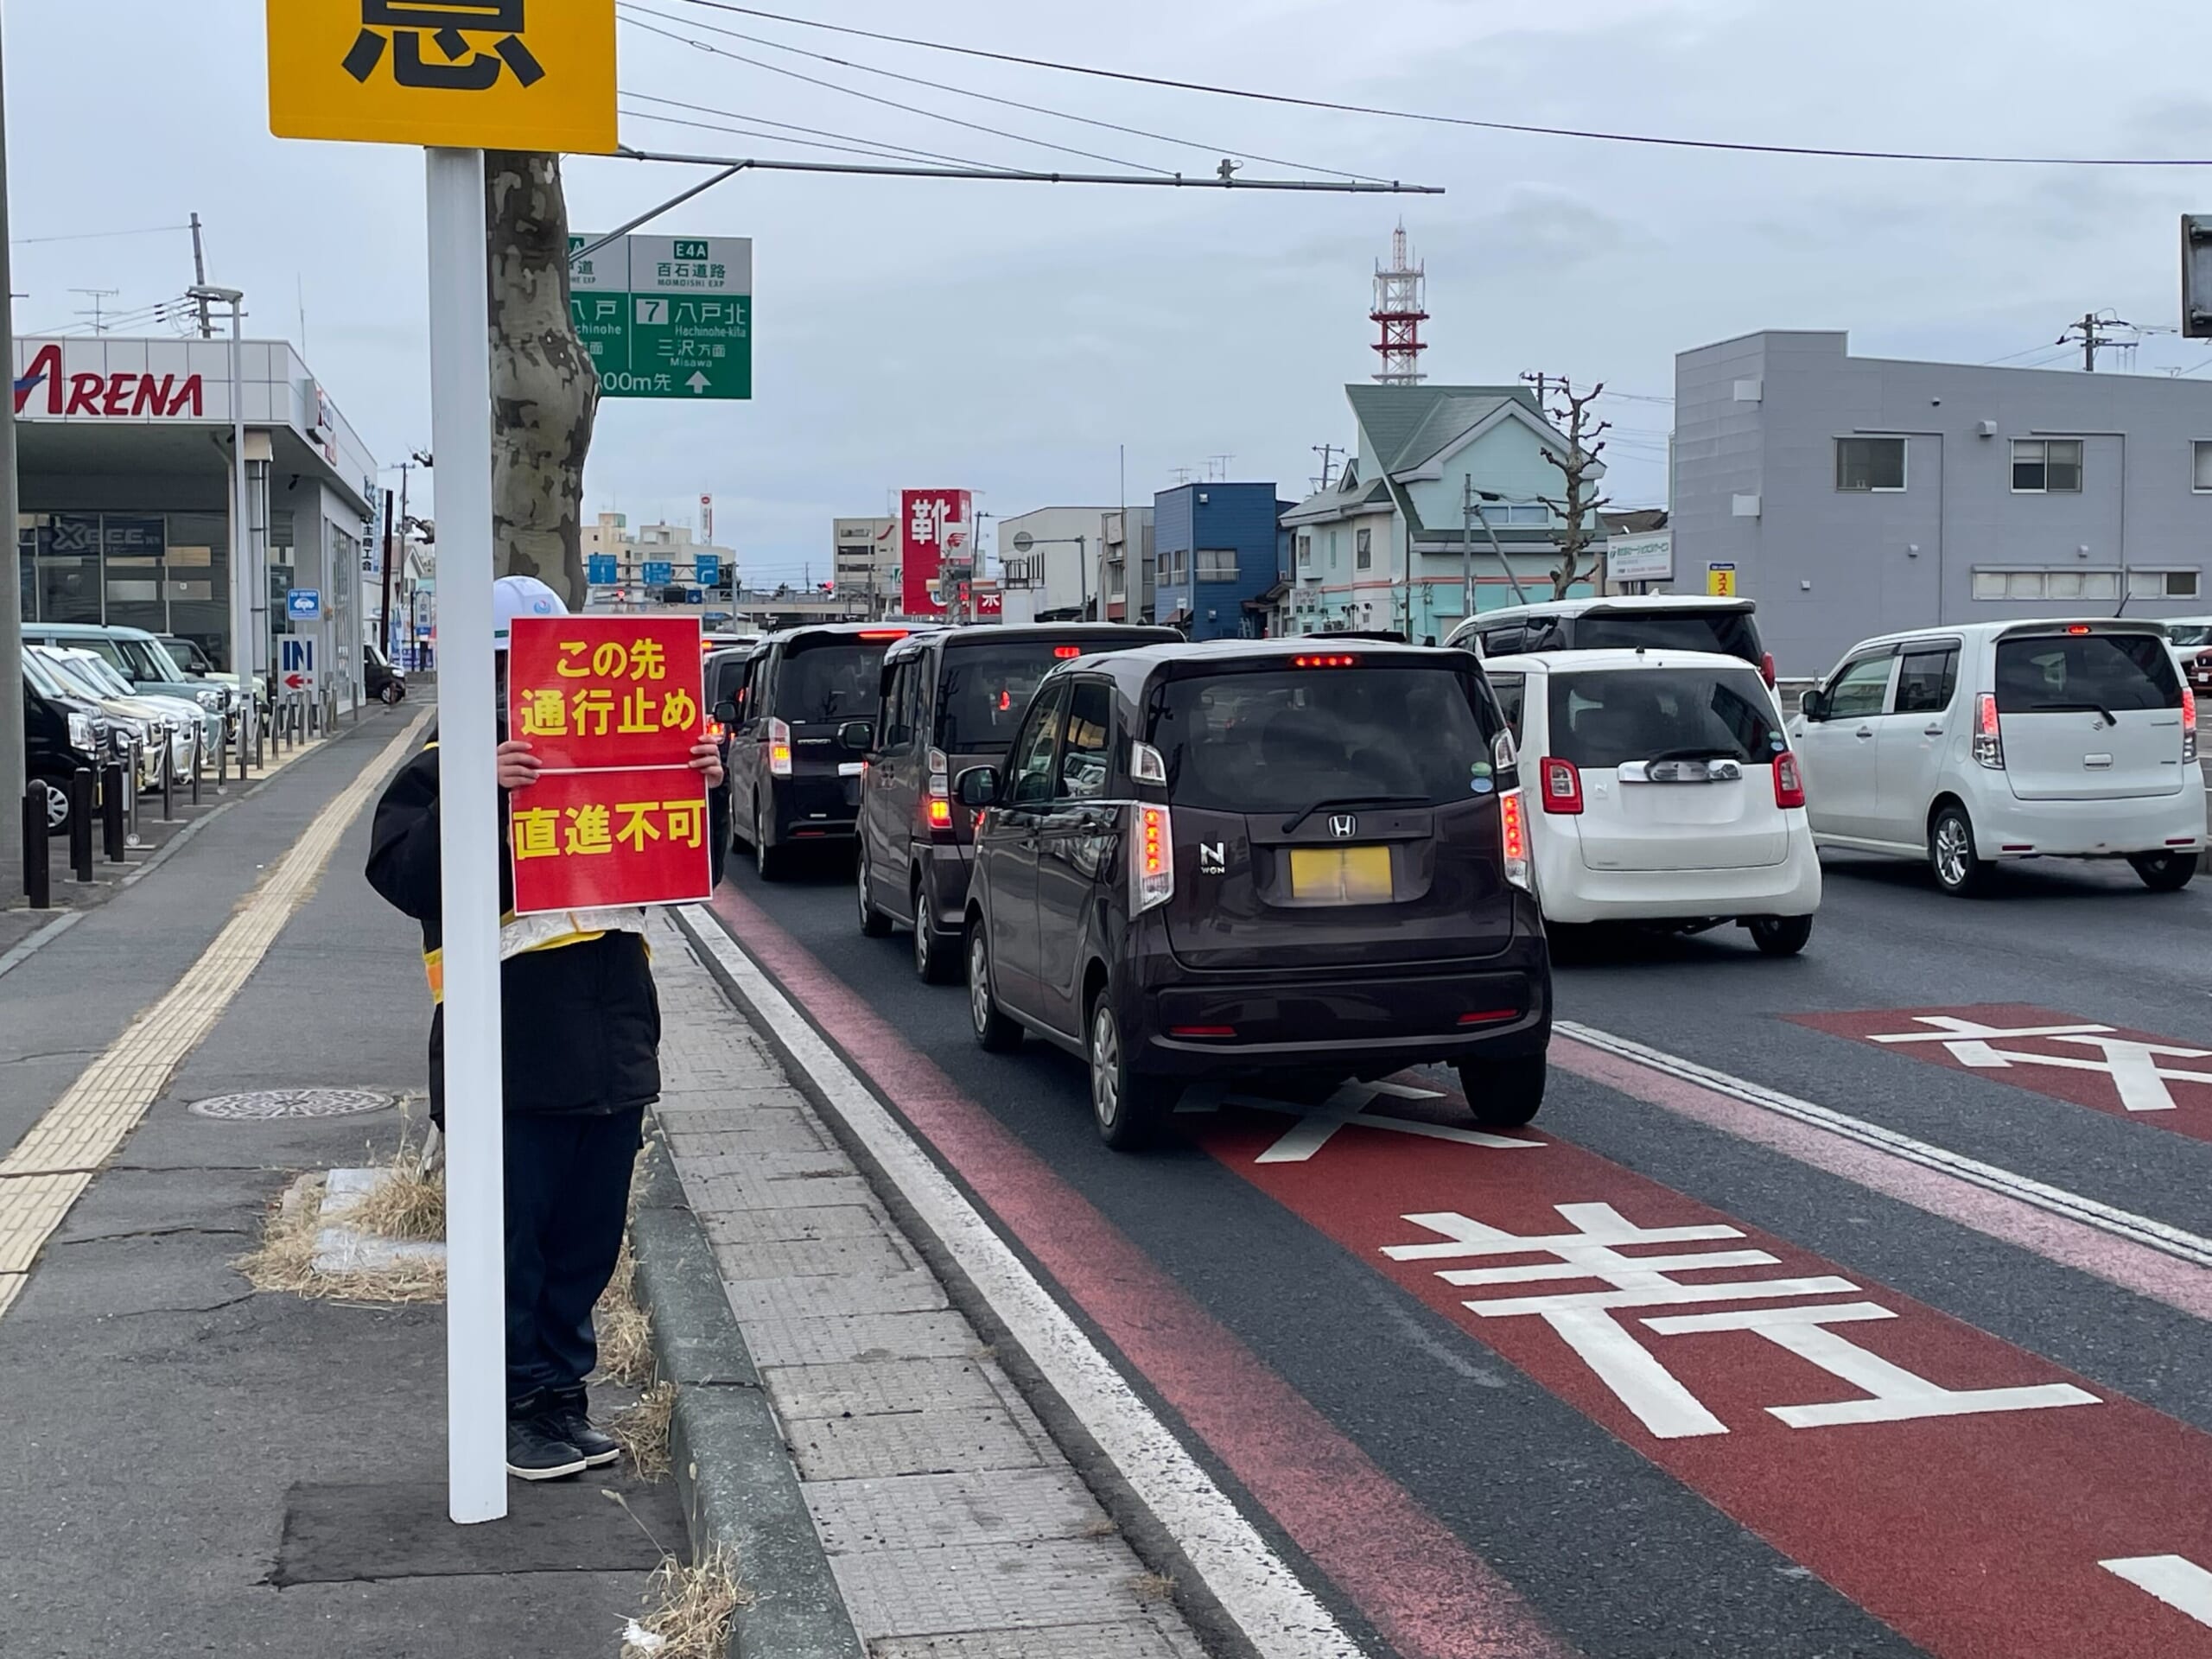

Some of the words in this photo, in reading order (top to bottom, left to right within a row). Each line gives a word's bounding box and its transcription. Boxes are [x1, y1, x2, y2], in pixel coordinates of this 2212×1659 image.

[676, 243, 707, 257] E4A
[657, 262, 726, 279] 百石道路
[658, 279, 705, 288] MOMOISHI
[645, 301, 660, 322] 7
[675, 302, 746, 325] 八戸北
[675, 326, 747, 338] Hachinohe-kita
[657, 340, 726, 358] 三沢方面
[670, 358, 713, 367] Misawa
[14, 344, 203, 416] ARENA
[597, 372, 672, 391] 00m先
[283, 640, 313, 671] IN
[556, 638, 666, 681] この先
[520, 687, 696, 736] 通行止め
[512, 799, 706, 861] 直進不可
